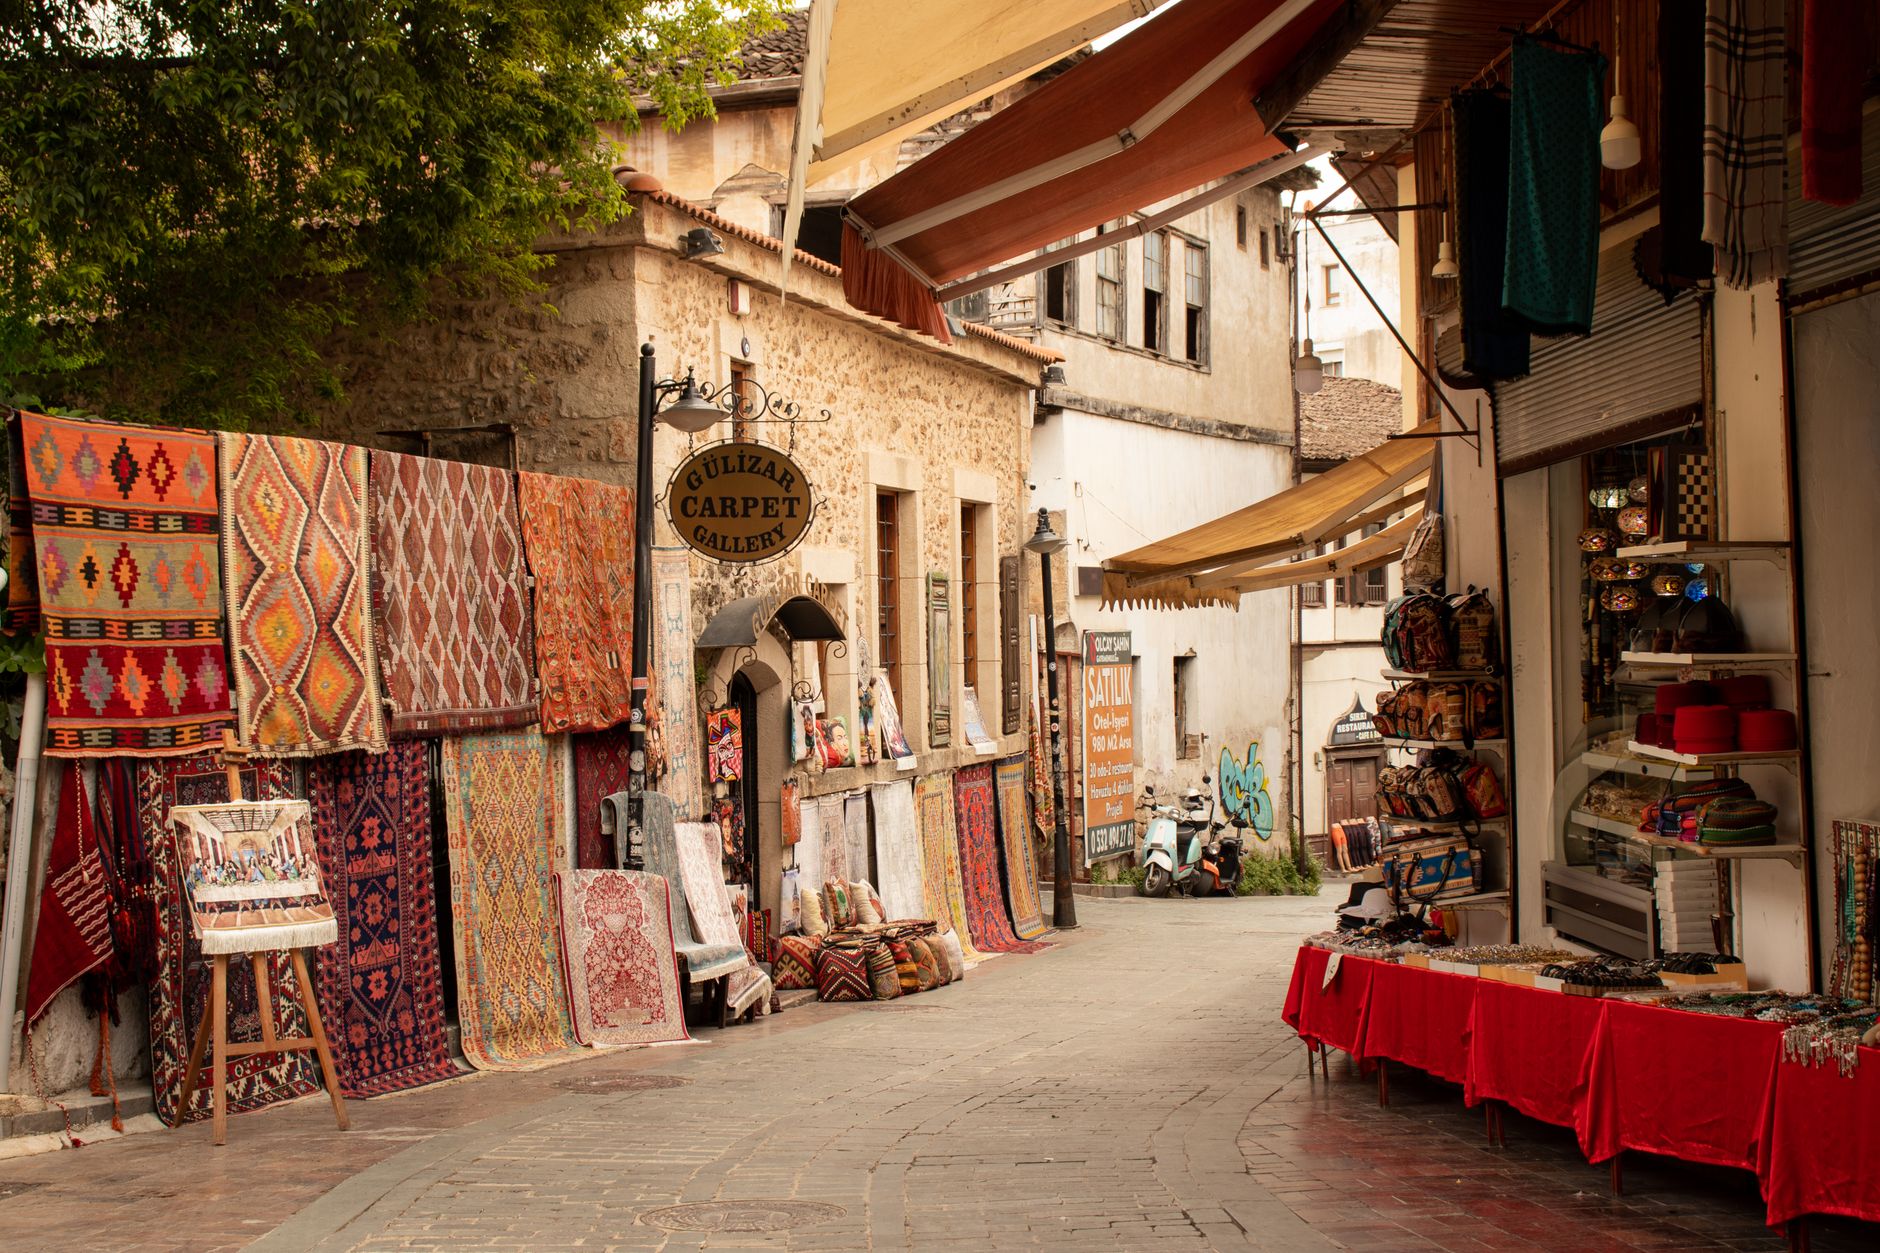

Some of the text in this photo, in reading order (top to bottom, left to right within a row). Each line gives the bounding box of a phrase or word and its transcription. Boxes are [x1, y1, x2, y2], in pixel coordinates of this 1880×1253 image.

[686, 450, 795, 494] GÜLİZAR
[680, 496, 800, 518] CARPET
[693, 522, 787, 553] GALLERY
[1095, 636, 1112, 652] OLCAY
[1088, 666, 1132, 709] SATILIK
[1336, 721, 1376, 733] RESTAURAN
[1092, 735, 1106, 752] 980
[1107, 734, 1118, 751] M2
[1091, 830, 1096, 854] 0
[1096, 828, 1108, 853] 532
